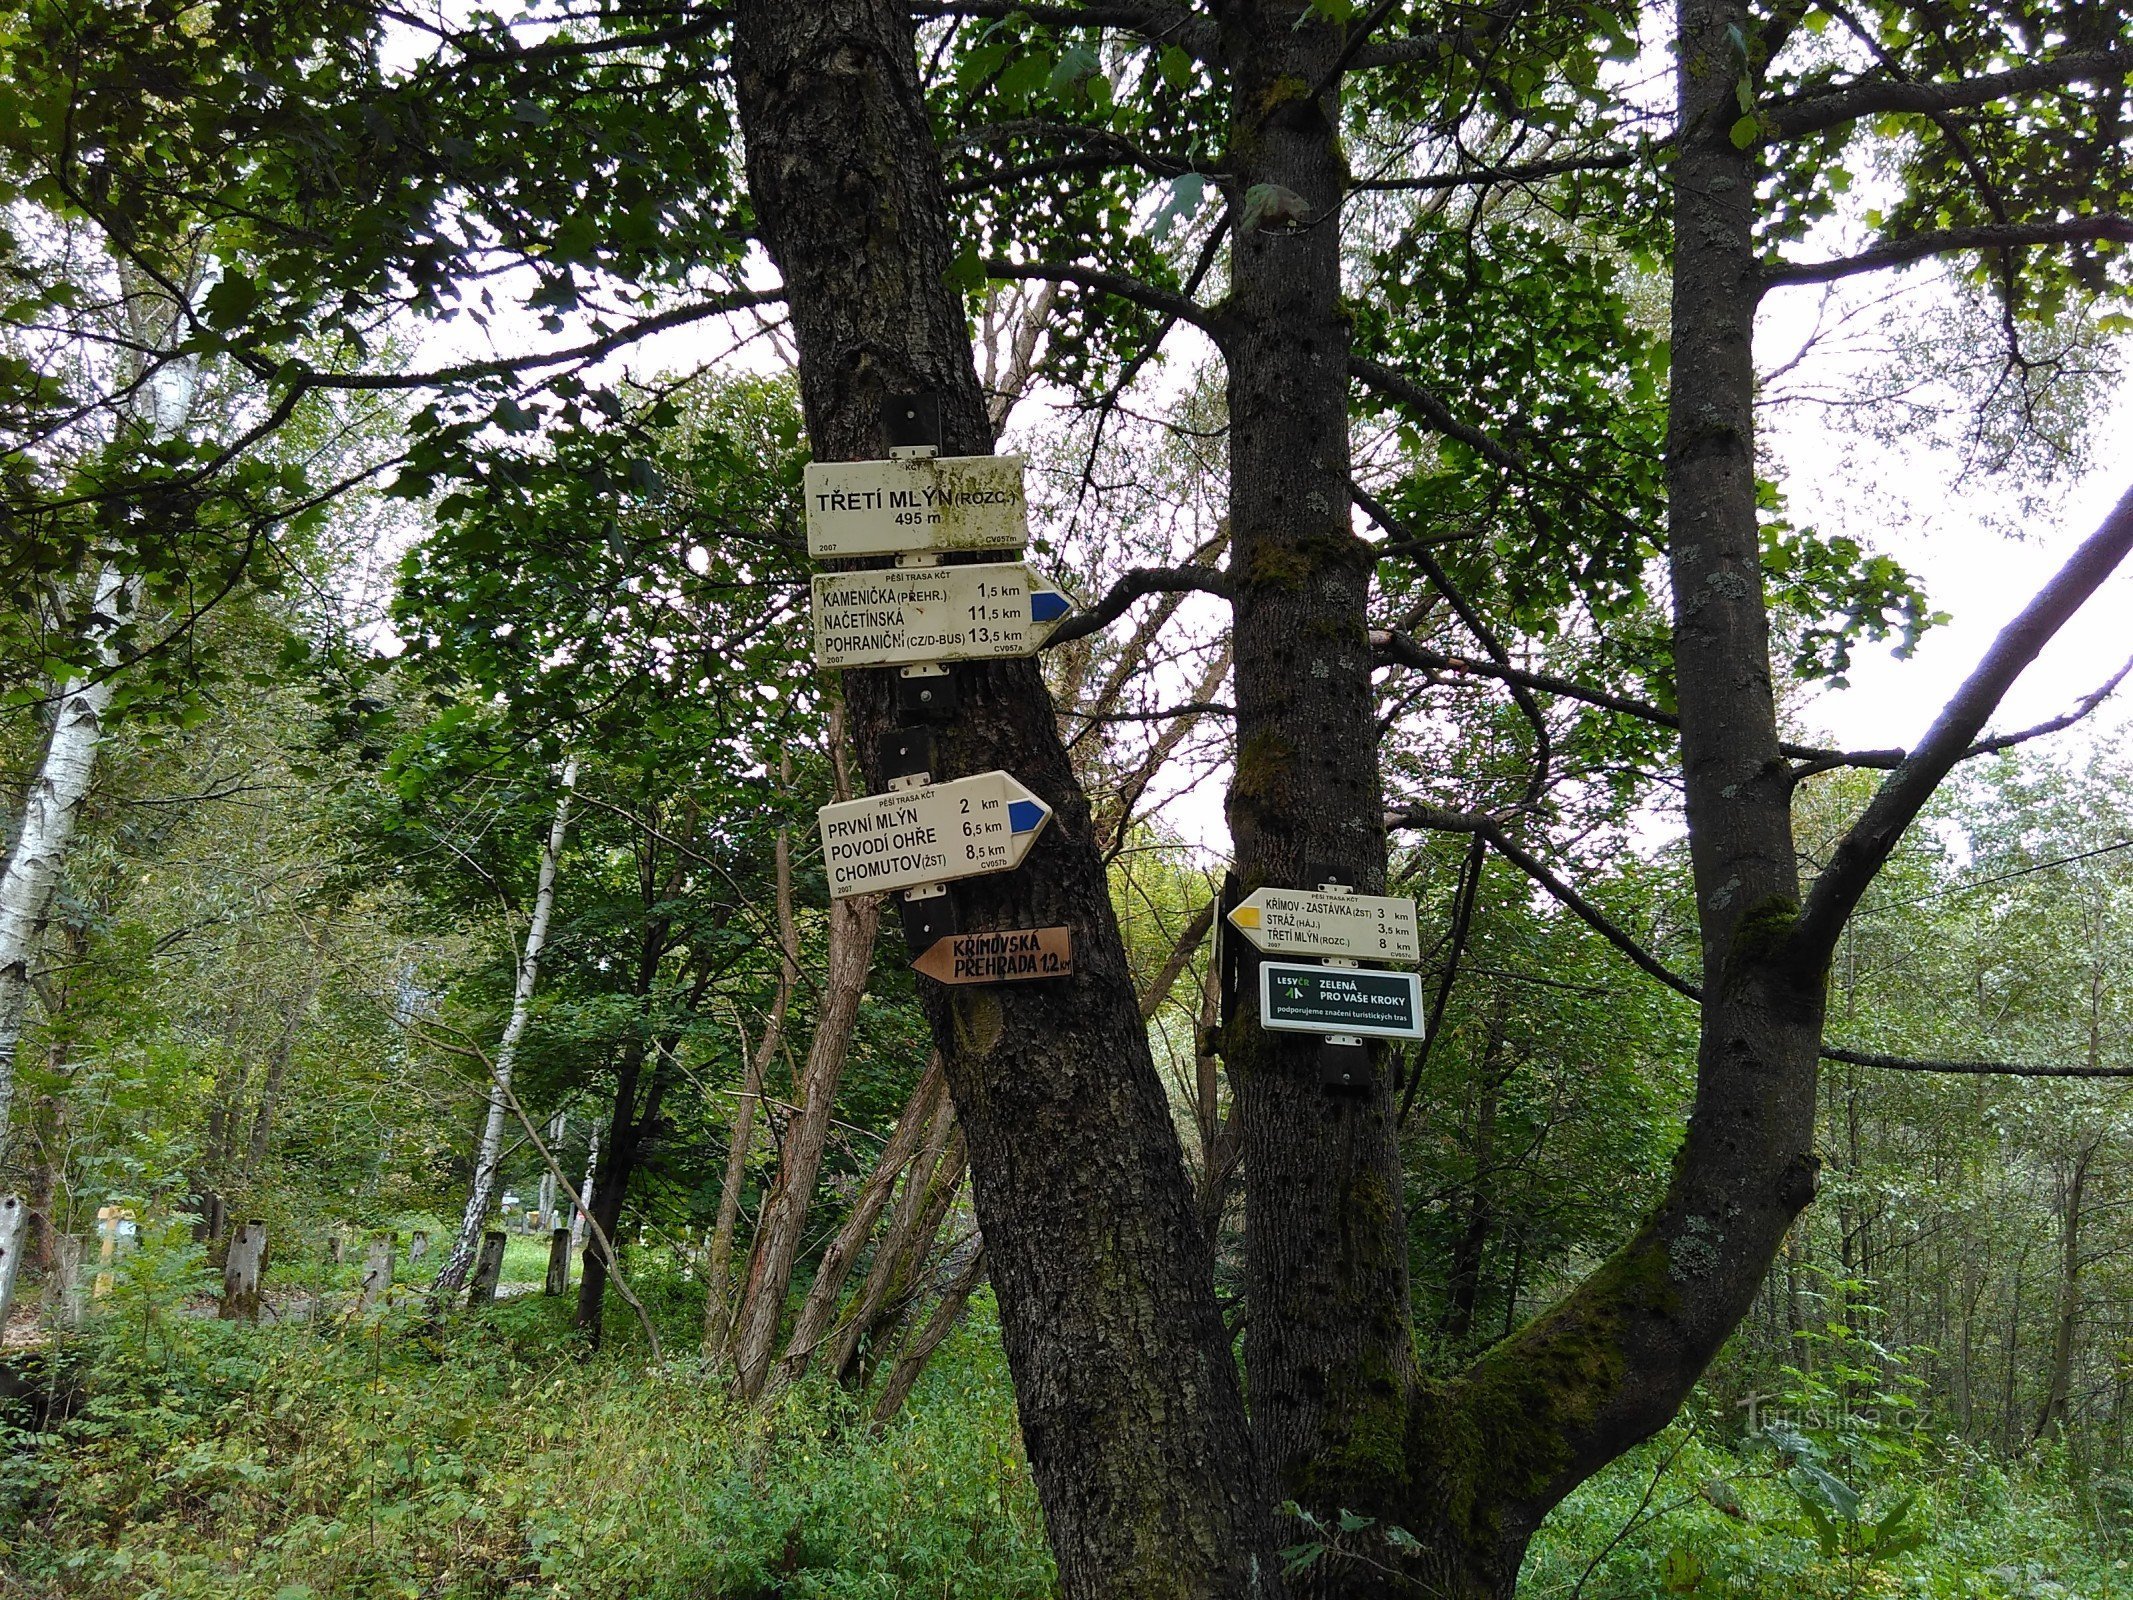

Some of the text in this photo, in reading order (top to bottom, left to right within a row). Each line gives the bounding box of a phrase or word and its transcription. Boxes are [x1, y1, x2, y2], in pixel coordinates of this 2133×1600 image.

[816, 488, 882, 511] TŘETÍ
[890, 486, 952, 508] MLÝN
[895, 513, 941, 525] 495 m
[885, 574, 904, 582] PĚŠÍ
[906, 573, 933, 581] TRASA
[823, 587, 895, 608] KAMENIČKA
[978, 583, 997, 598] 1,5
[1002, 586, 1020, 596] km
[824, 605, 1020, 630] NAČETÍNSKÁ 11,5 km
[969, 627, 1000, 643] 13,5
[1003, 631, 1022, 641] km
[827, 656, 843, 664] 2007
[879, 791, 935, 808] PĚŠÍ TRASA KČT
[828, 798, 999, 839] PRVNÍ MLÝN 2 km
[832, 821, 1002, 860] POVODÍ OHŘE 6,5 km
[966, 844, 985, 860] 8,5
[988, 844, 1005, 856] km
[838, 885, 852, 893] 2007
[1266, 898, 1299, 912] KŘÍMOV
[1307, 901, 1352, 915] ZASTÁVKA
[1377, 909, 1385, 919] 3
[1395, 912, 1408, 920] km
[1267, 914, 1295, 926] STRÁŽ
[1378, 923, 1393, 935] 3,5
[1395, 927, 1409, 935] km
[954, 930, 1041, 957] KŘÍMOVSKÁ
[1268, 928, 1292, 941] TŘETÍ
[1294, 931, 1319, 943] MLÝN
[1379, 939, 1387, 949] 8
[1397, 942, 1410, 951] km
[1320, 980, 1357, 991] ZELENÁ
[1320, 992, 1405, 1006] PRO VAŠE KROKY
[1277, 1006, 1323, 1016] podporujeme
[1353, 1011, 1392, 1021] turistických
